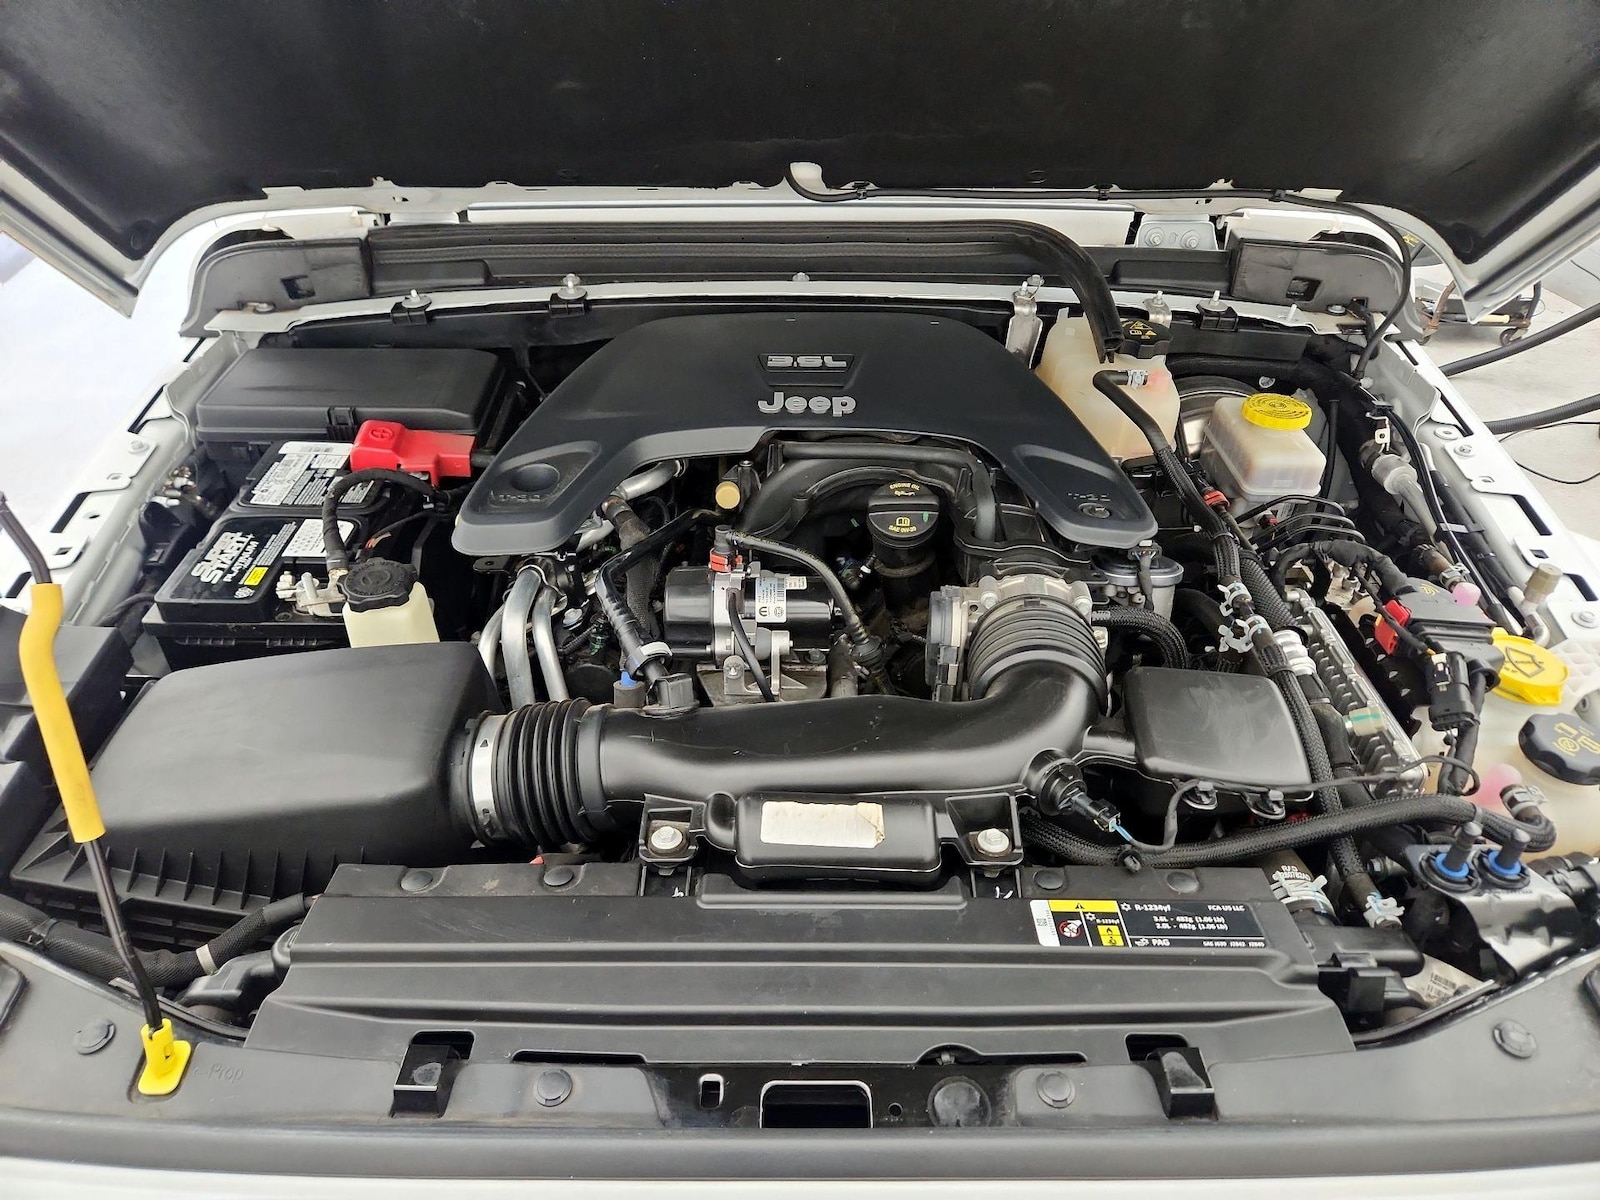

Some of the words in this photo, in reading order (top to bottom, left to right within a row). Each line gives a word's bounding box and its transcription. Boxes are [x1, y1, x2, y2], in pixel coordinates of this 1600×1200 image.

[757, 391, 857, 417] Jeep
[889, 482, 911, 490] ENGINE
[911, 482, 920, 491] OIL
[888, 524, 900, 533] SAE
[191, 531, 242, 577] SUPER
[200, 535, 250, 585] START
[222, 541, 259, 583] PLATINUM
[1134, 904, 1171, 912] R-1234yf
[1151, 938, 1170, 946] PAG
